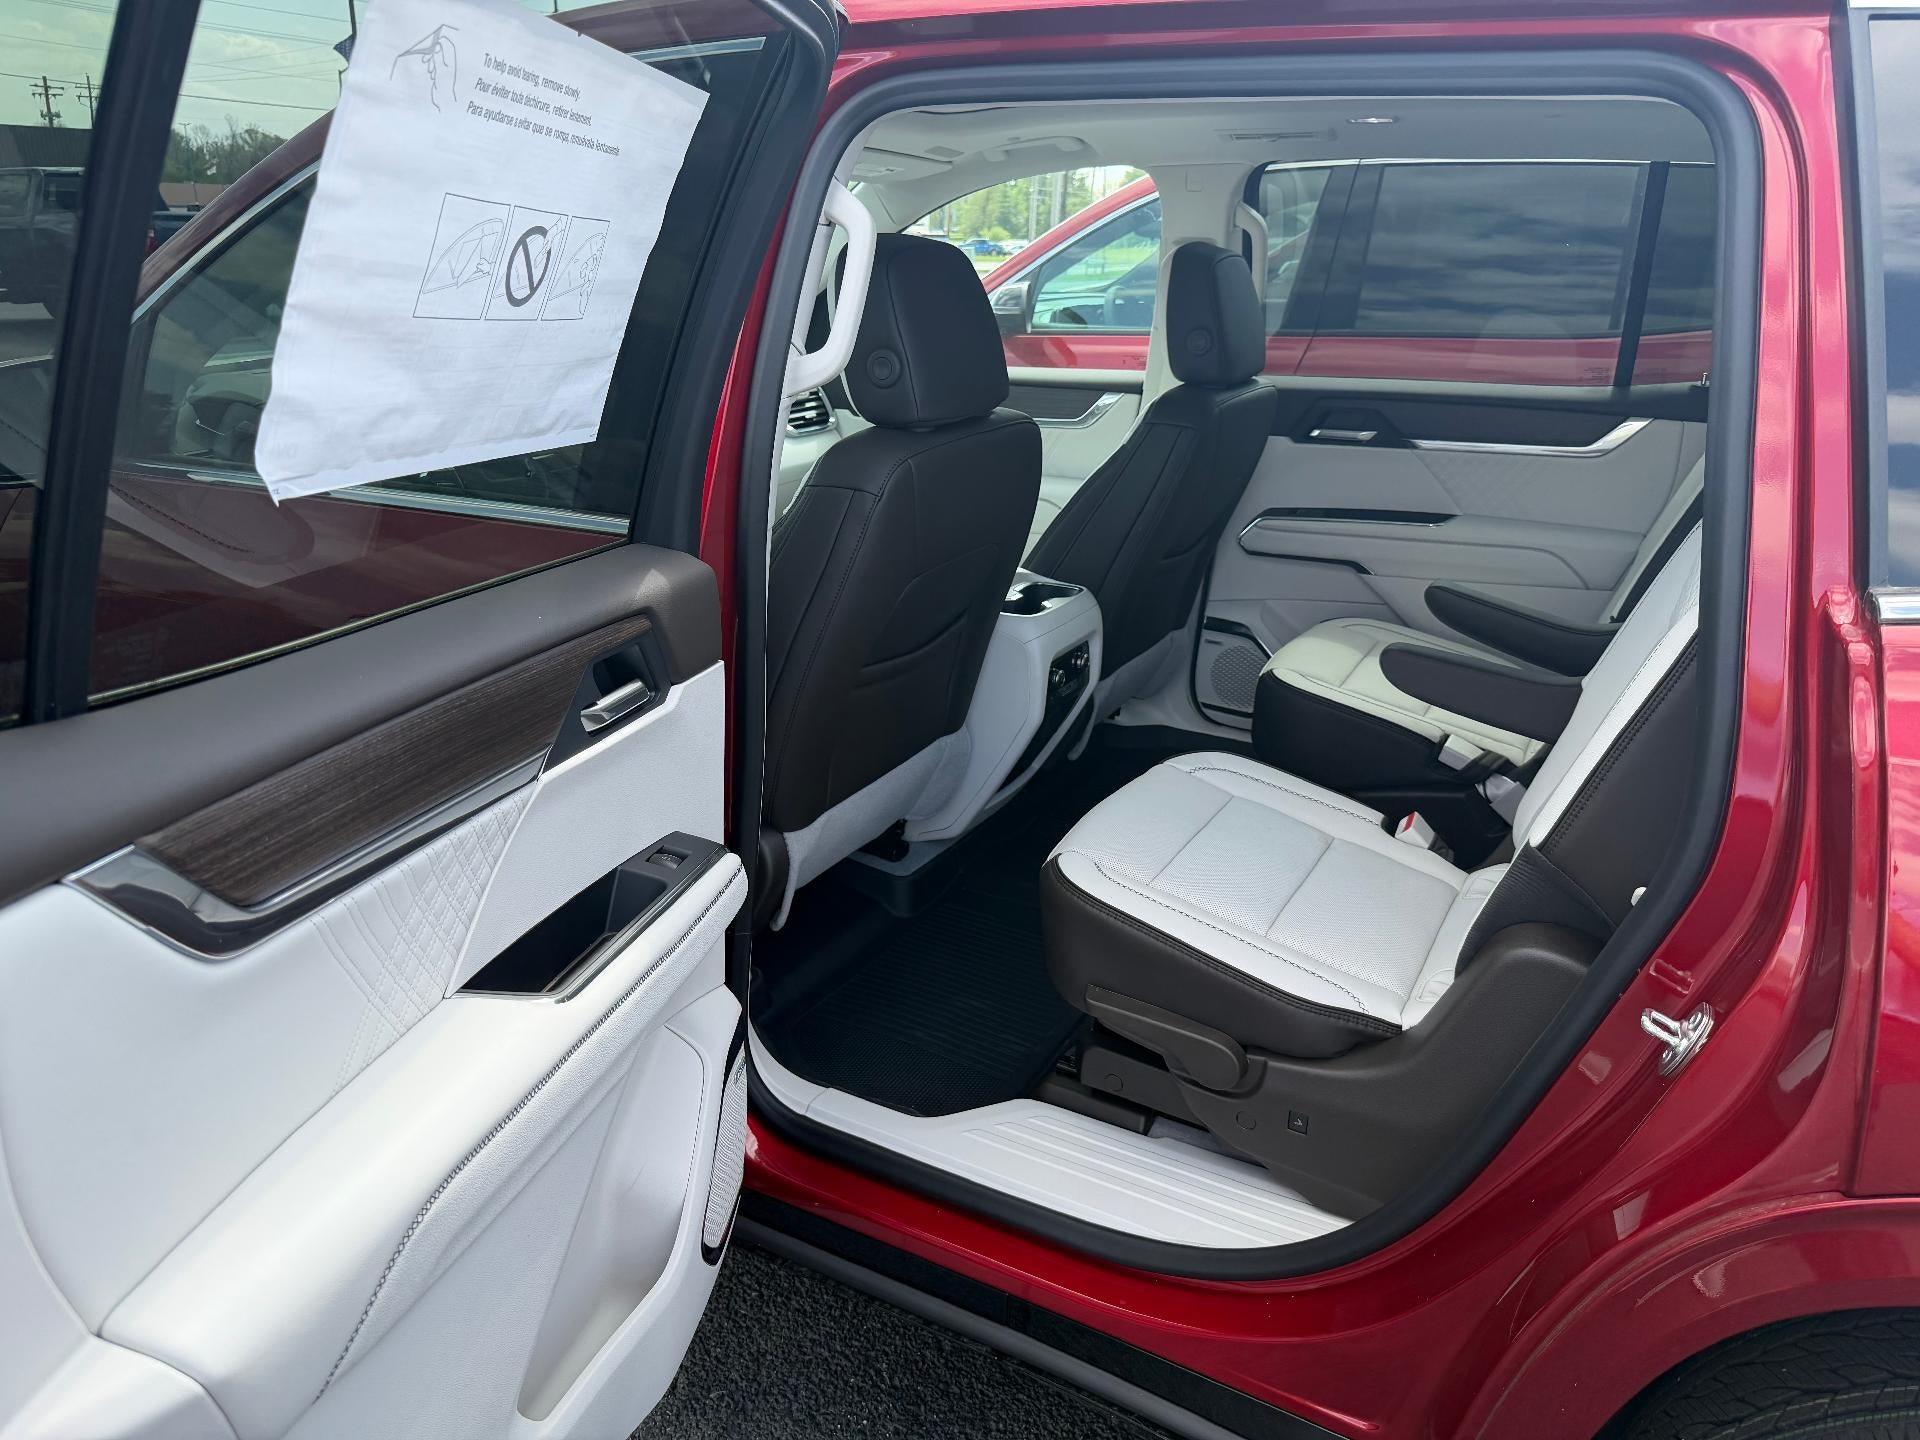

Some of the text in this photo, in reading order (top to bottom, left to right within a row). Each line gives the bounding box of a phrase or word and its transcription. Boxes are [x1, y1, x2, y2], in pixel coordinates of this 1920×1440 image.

[475, 77, 491, 92] Pour
[491, 82, 511, 99] éviter
[484, 53, 492, 68] To
[492, 57, 506, 75] help
[507, 64, 522, 79] avoid
[541, 77, 563, 93] remove
[467, 100, 483, 116] Para
[484, 109, 514, 127] ayudarse
[532, 122, 544, 135] que
[545, 126, 553, 136] se
